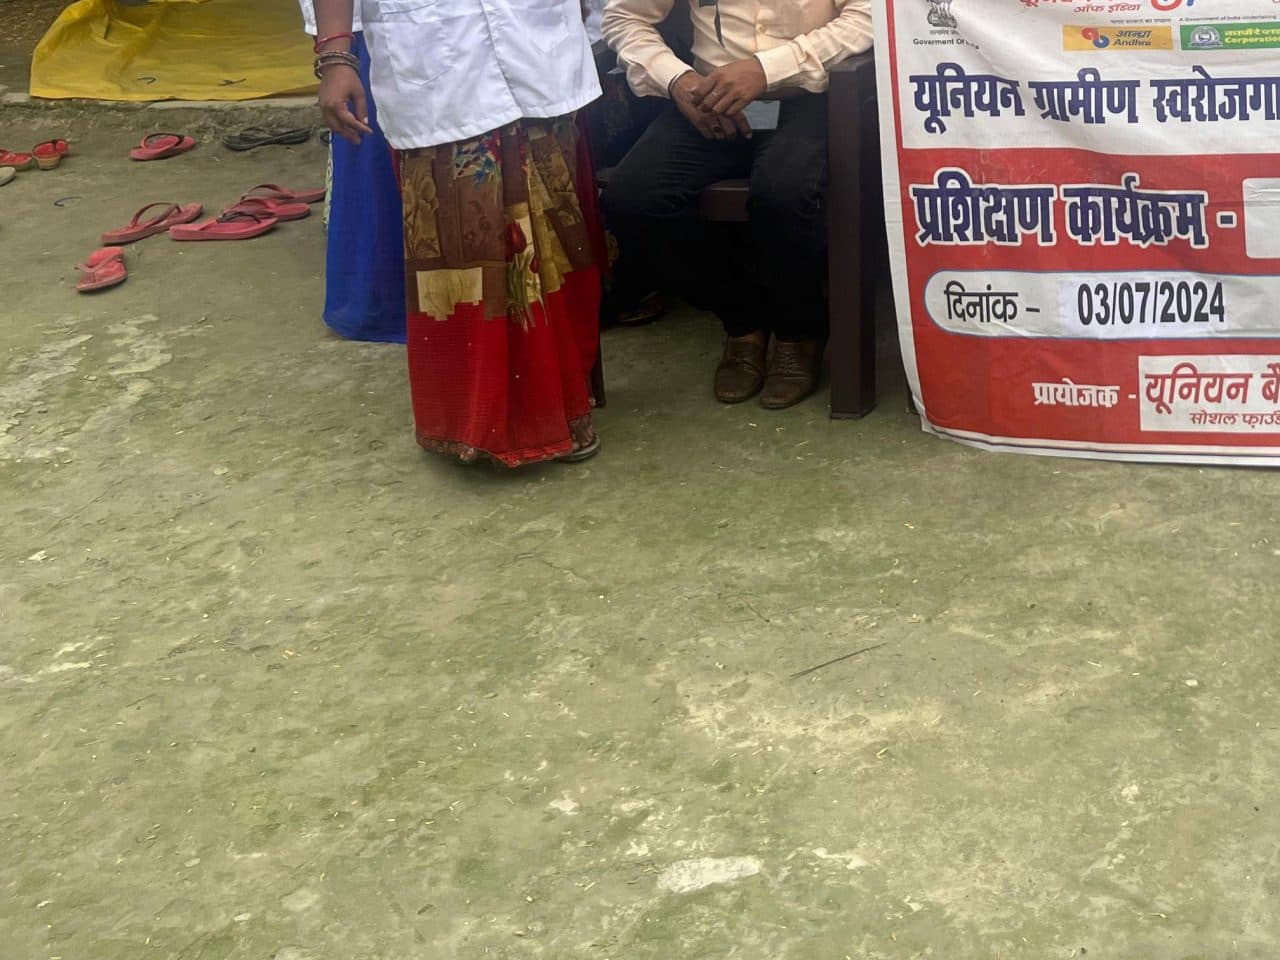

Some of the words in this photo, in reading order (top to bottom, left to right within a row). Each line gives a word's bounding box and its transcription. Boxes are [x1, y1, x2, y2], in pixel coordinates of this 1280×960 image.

[1113, 38, 1151, 46] Andhra
[909, 62, 1025, 134] यूनियन
[1028, 67, 1140, 124] ग्रामीण
[911, 170, 1054, 243] प्रशिक्षण
[1063, 176, 1206, 246] कार्यक्रम
[944, 280, 1018, 323] दिनांक
[1078, 282, 1225, 326] 03/07/2024
[1031, 378, 1120, 408] प्रायोजक
[1145, 362, 1253, 415] यूनियन
[1189, 409, 1237, 425] सोशल
